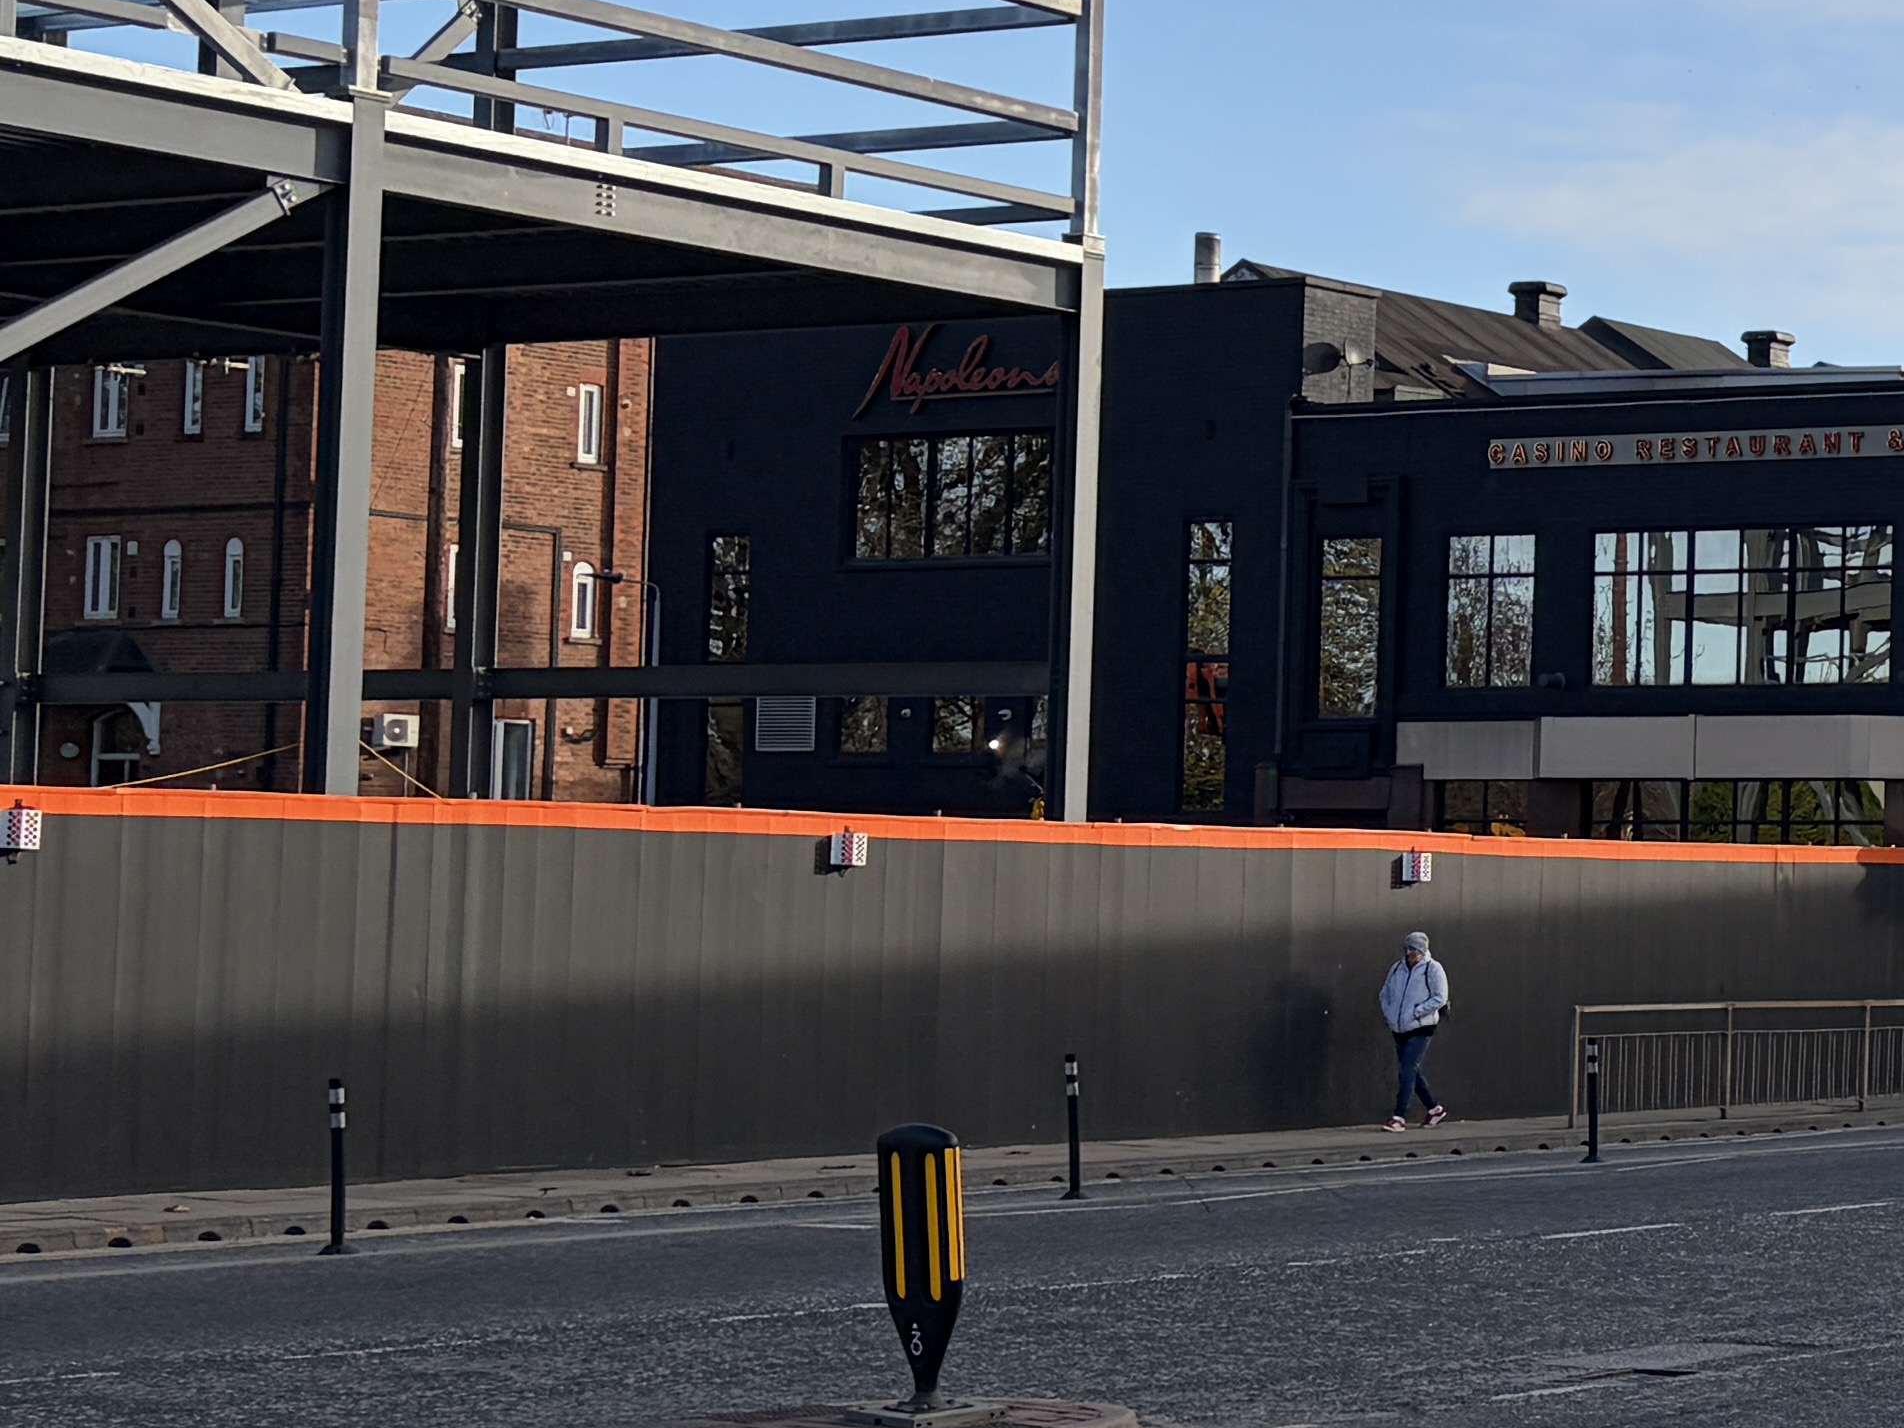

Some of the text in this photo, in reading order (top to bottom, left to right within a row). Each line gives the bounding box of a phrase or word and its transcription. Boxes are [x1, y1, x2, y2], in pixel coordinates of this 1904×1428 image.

[851, 323, 1061, 420] Napoleons
[1488, 440, 1615, 464] CASINO
[1635, 431, 1865, 461] RESTAURANT
